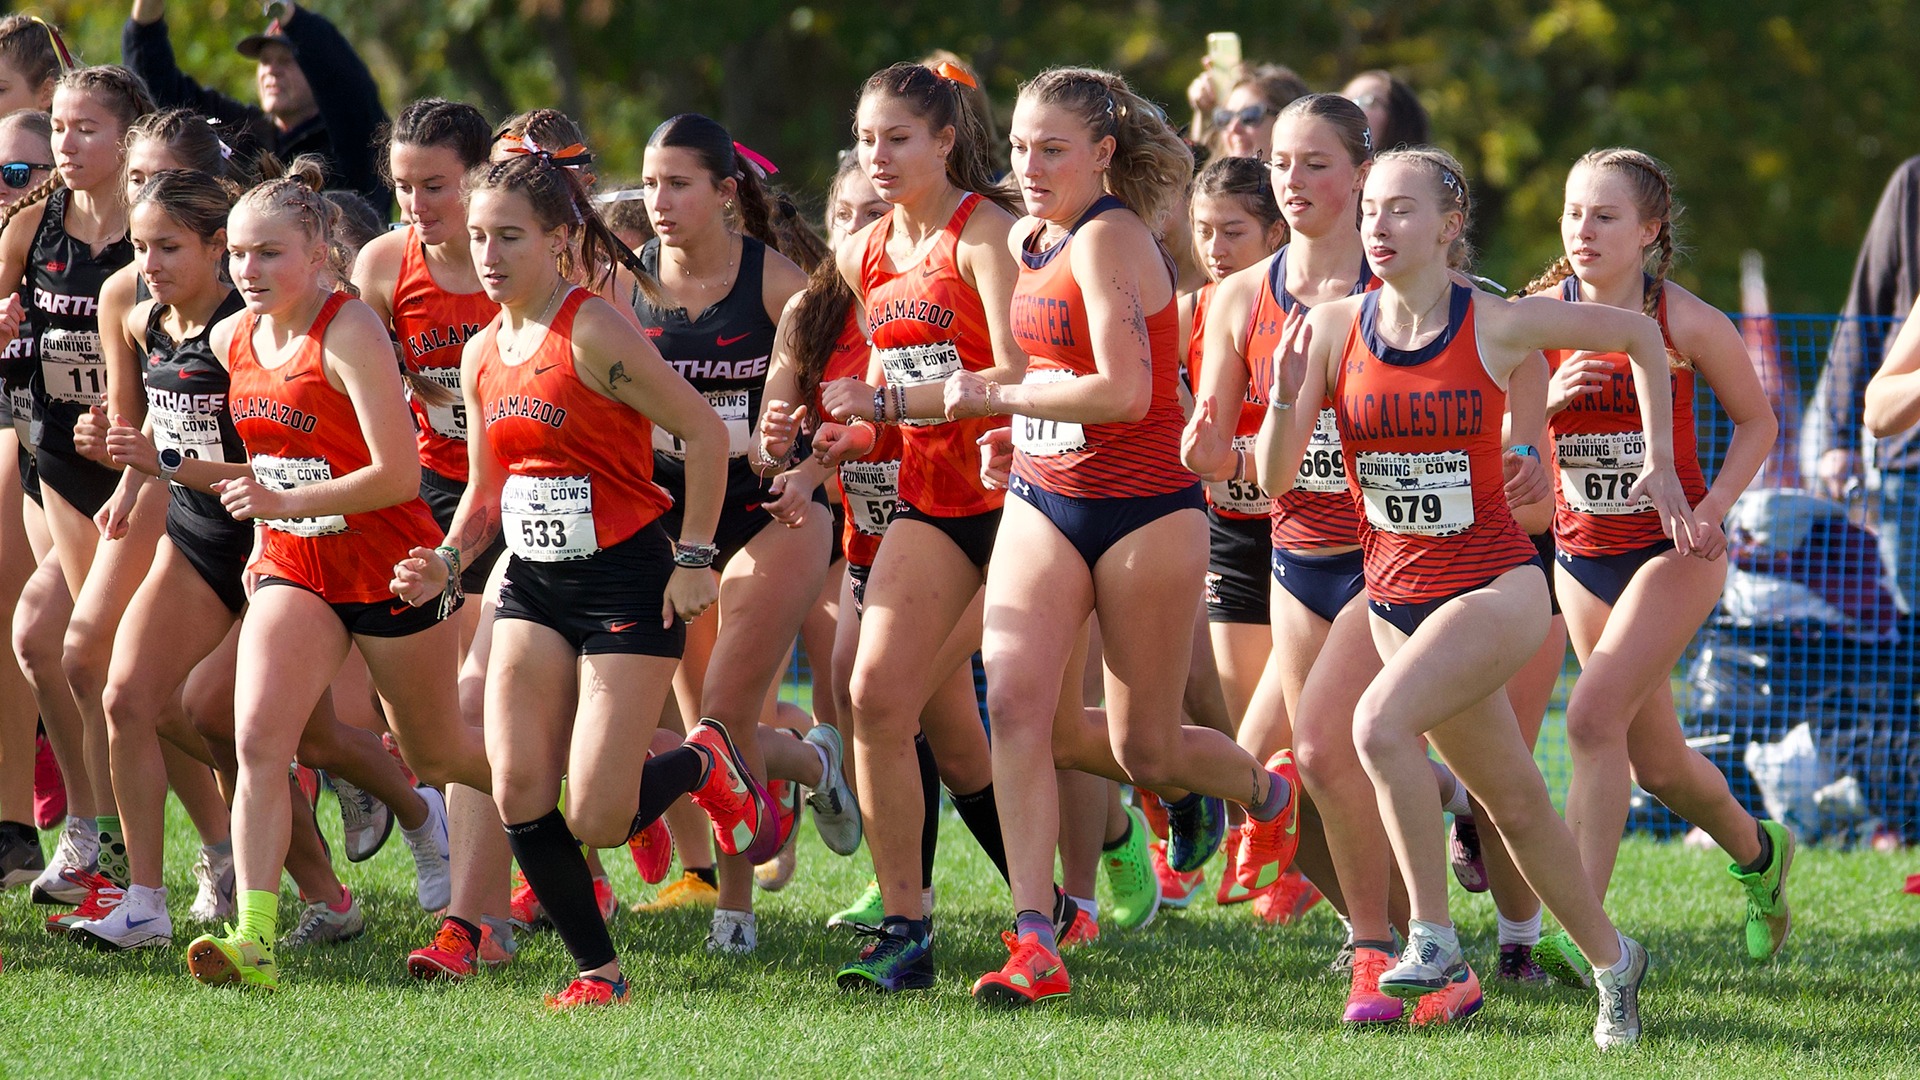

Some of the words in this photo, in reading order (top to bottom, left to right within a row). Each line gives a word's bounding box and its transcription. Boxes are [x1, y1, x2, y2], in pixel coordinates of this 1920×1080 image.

[868, 299, 955, 334] ALAMAZOO
[43, 338, 92, 352] RUNNING
[666, 354, 769, 379] THAGE
[923, 349, 958, 367] COWS
[709, 395, 747, 408] COWS
[231, 396, 318, 434] ALAMAZOO
[484, 395, 567, 429] ALAMAZOO
[1339, 389, 1483, 441] MACALESTER
[182, 420, 217, 432] COWS
[1612, 435, 1643, 443] COLLEGE
[1559, 444, 1610, 457] RUNNING
[1624, 442, 1646, 455] CO
[1300, 449, 1347, 478] 669
[1360, 462, 1410, 477] RUNNING
[1425, 459, 1468, 475] COWS
[297, 468, 330, 481] COWS
[843, 470, 886, 485] RUNNING
[551, 487, 588, 501] COWS
[1227, 480, 1270, 501] 53
[1585, 472, 1638, 501] 678
[1385, 493, 1442, 523] 679
[521, 519, 567, 548] 533
[1418, 522, 1457, 530] CHAMPIONSHIP
